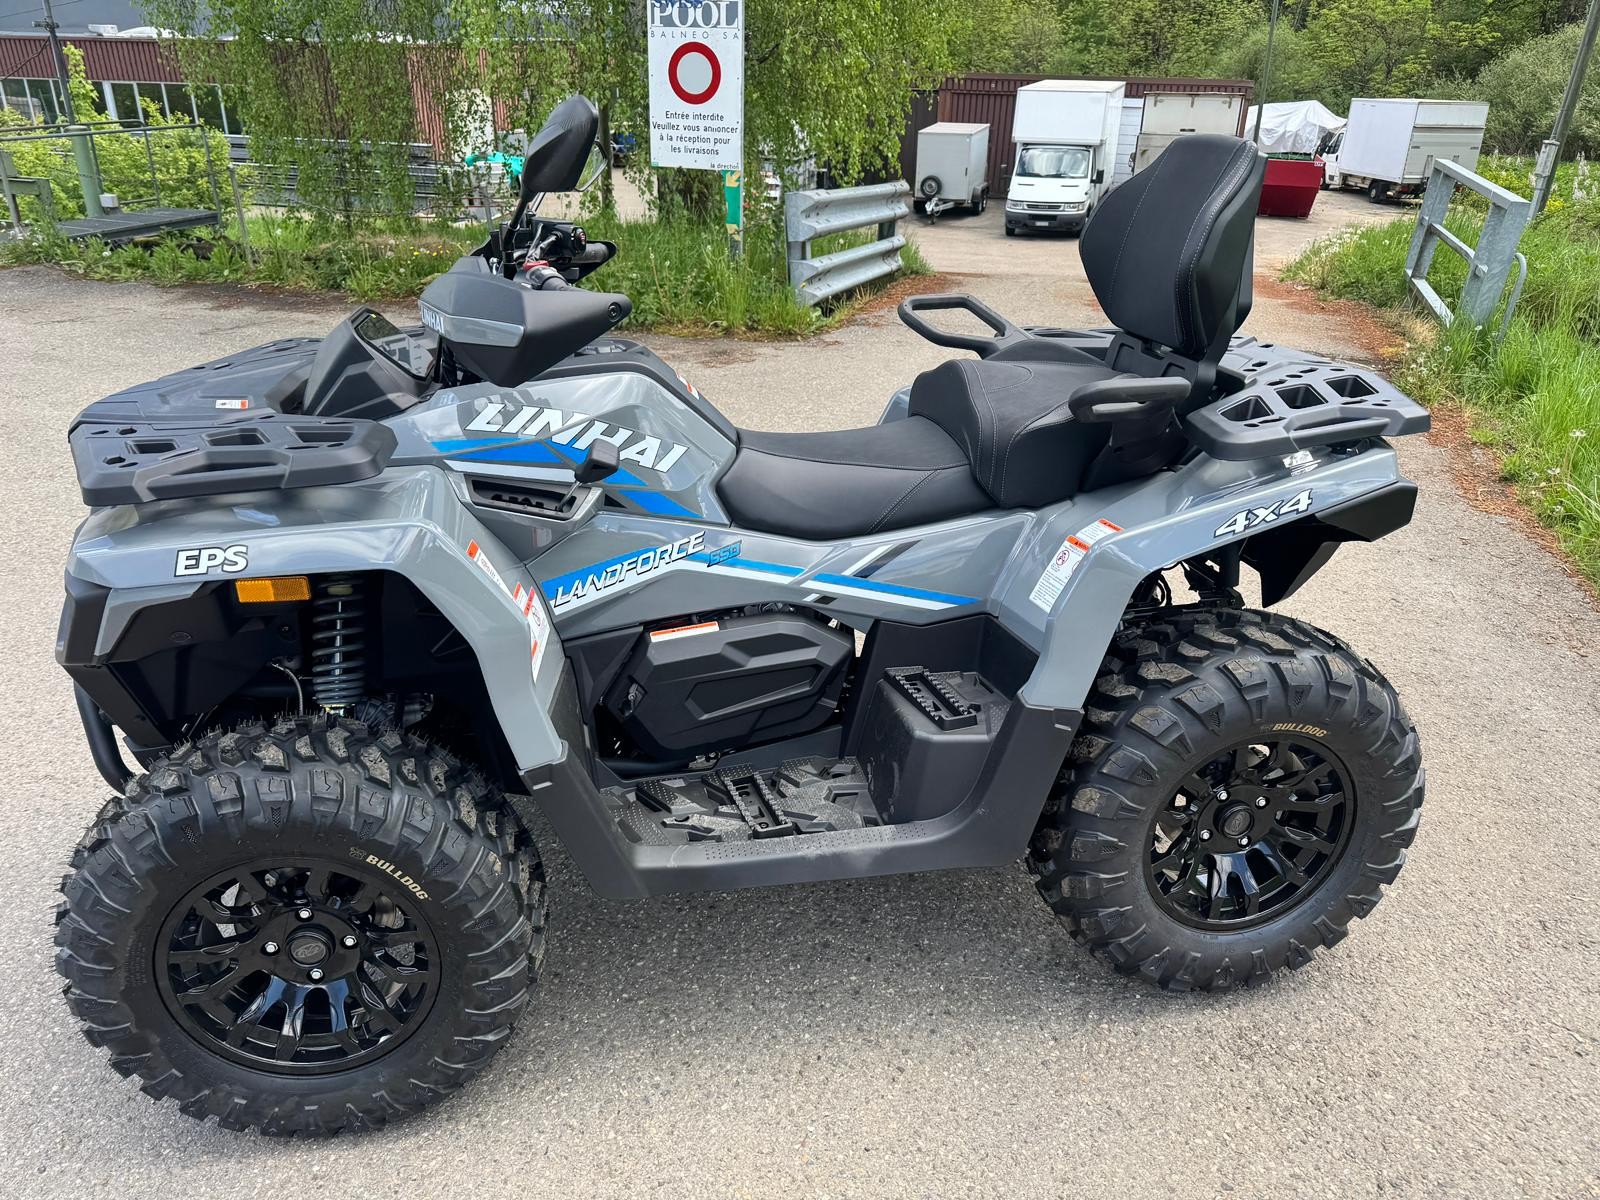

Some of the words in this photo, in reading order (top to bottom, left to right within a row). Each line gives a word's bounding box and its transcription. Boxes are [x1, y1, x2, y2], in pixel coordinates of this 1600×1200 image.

[651, 0, 738, 28] POOL
[650, 30, 709, 39] BALNEO
[723, 32, 739, 40] SA
[665, 110, 690, 120] Entrée
[692, 112, 724, 121] interdite
[652, 121, 680, 131] Veuillez
[682, 124, 700, 132] vous
[703, 125, 738, 134] annoncer
[659, 132, 664, 141] à
[666, 133, 673, 142] la
[675, 134, 711, 145] réception
[713, 137, 731, 146] pour
[670, 144, 681, 153] les
[683, 145, 719, 156] livraisons
[464, 402, 690, 473] LINHAI
[174, 545, 249, 577] EPS
[553, 531, 707, 608] LANDFORCE
[1271, 723, 1328, 738] BULLDOG
[365, 854, 429, 900] BULLDOG
